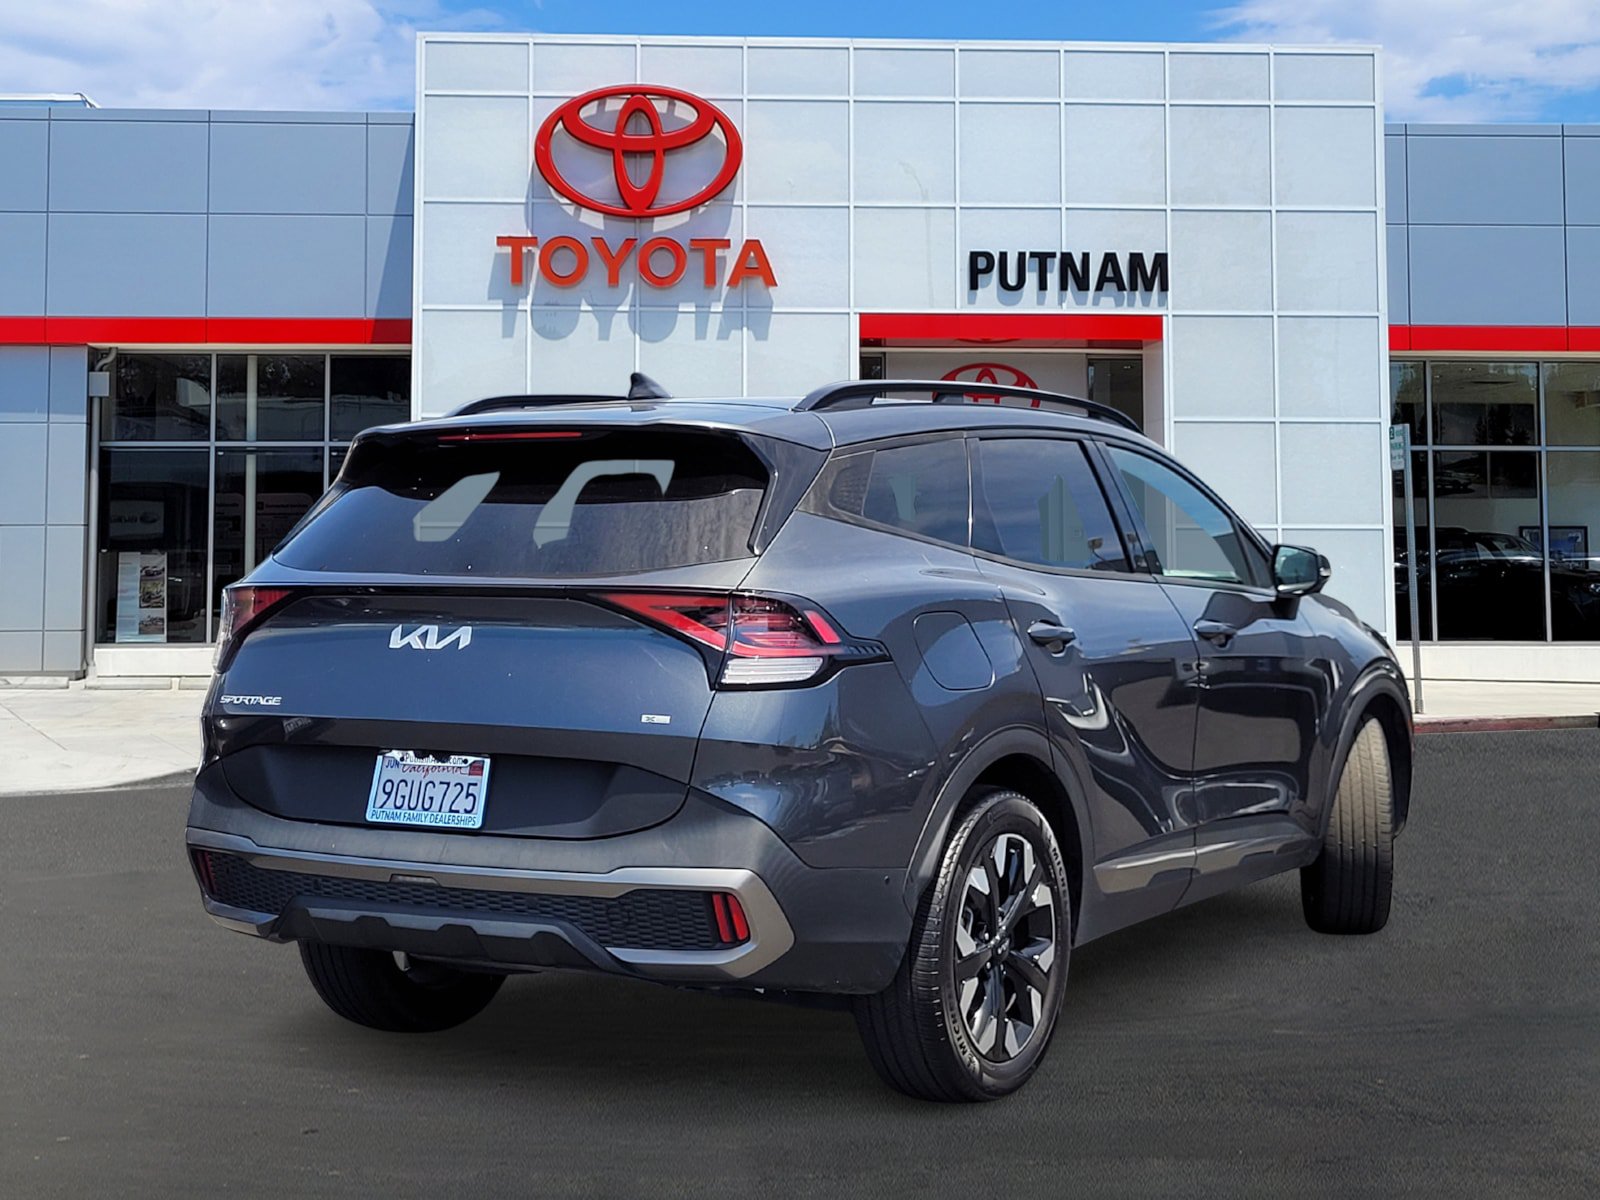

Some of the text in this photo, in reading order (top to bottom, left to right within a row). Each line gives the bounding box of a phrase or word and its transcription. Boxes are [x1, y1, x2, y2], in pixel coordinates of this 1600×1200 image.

[496, 236, 778, 288] TOYOTA
[969, 251, 1169, 292] PUTNAM
[389, 624, 472, 650] KIA
[220, 695, 282, 706] SPORTAGE
[380, 779, 478, 814] 9GUG725
[371, 809, 477, 826] PUTNAM FAMILY DEALERSHIPS
